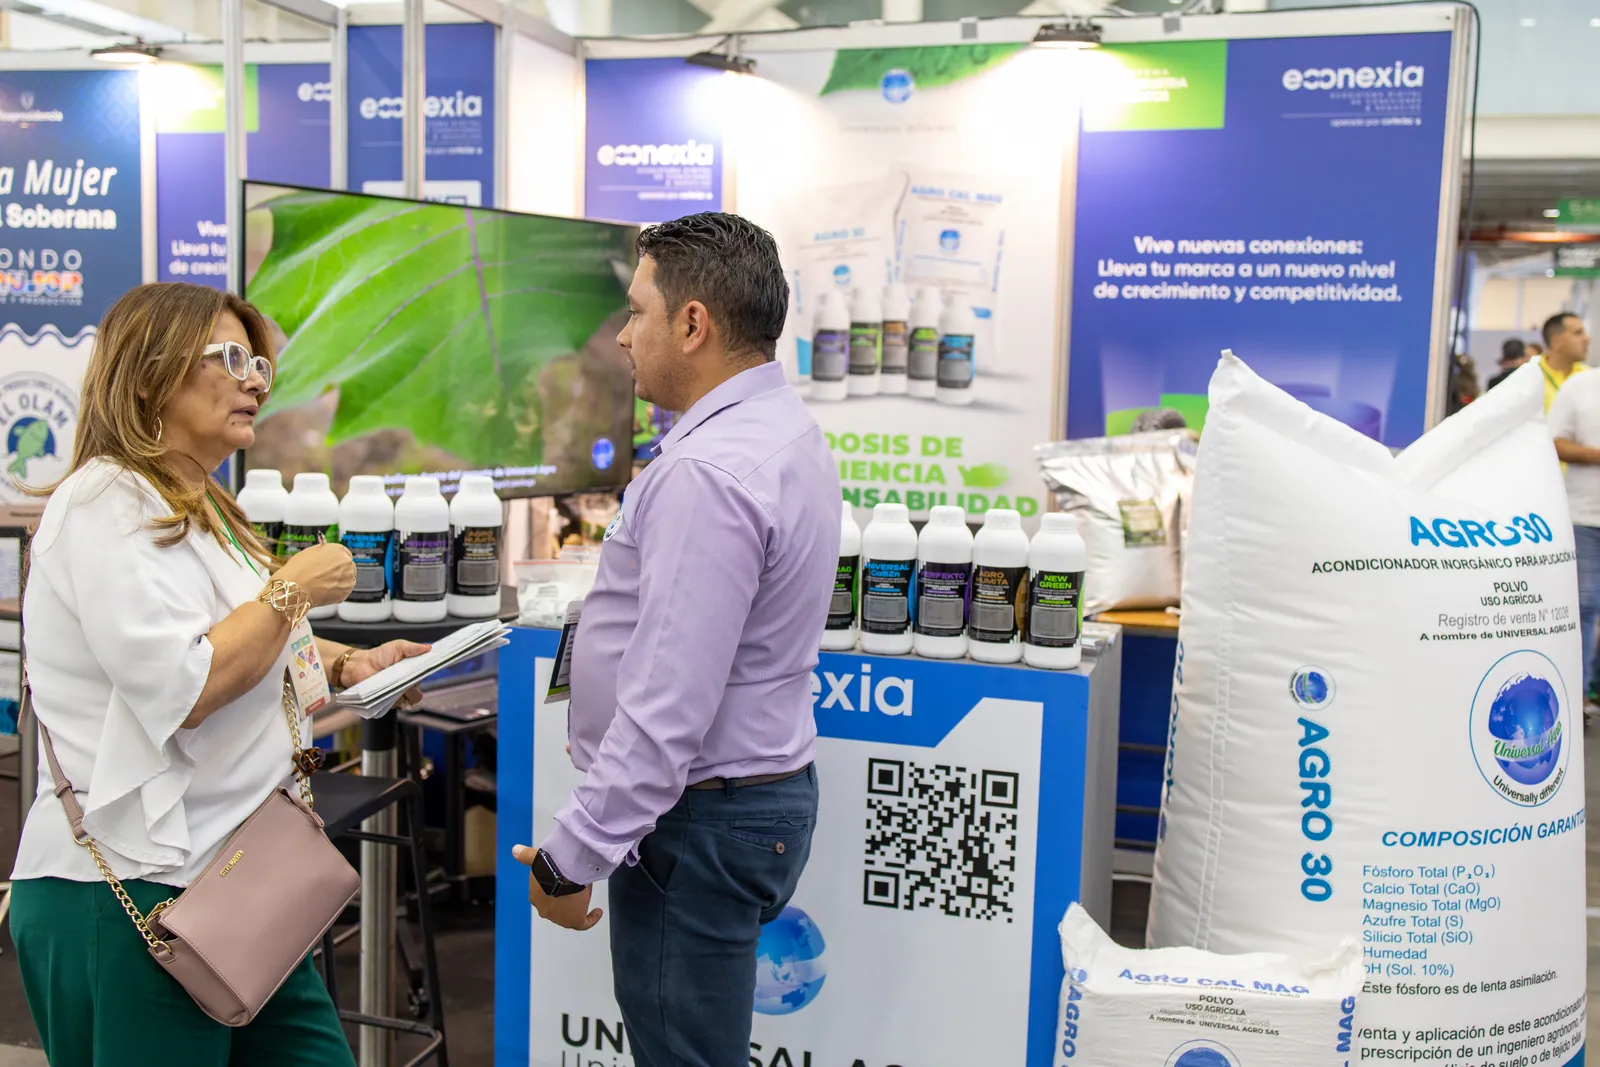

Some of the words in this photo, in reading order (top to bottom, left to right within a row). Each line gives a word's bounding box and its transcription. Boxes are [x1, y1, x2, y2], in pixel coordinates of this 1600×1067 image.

[1282, 61, 1424, 91] econexia
[23, 159, 117, 205] Mujer
[6, 203, 117, 229] Soberana
[1134, 236, 1174, 254] Vive
[1178, 238, 1245, 255] nuevas
[1249, 236, 1363, 255] conexiones:
[1098, 259, 1147, 276] Lleva
[1152, 261, 1170, 277] tu
[1174, 262, 1235, 278] marca
[1239, 263, 1252, 277] a
[1257, 263, 1281, 278] un
[1285, 263, 1345, 279] nuevo
[1349, 261, 1396, 279] nivel
[1094, 283, 1119, 299] de
[1121, 281, 1231, 300] crecimiento
[1234, 286, 1246, 303] y
[1249, 283, 1402, 304] competitividad.
[921, 436, 963, 457] DE
[1311, 558, 1439, 574] ACONDICIONADOR
[1441, 556, 1513, 571] INORGÁNICO
[1515, 555, 1538, 568] PARA
[1039, 581, 1072, 590] GREEN
[1044, 574, 1068, 582] NEW
[1493, 580, 1529, 593] POLVO
[1480, 596, 1500, 606] USO
[1502, 593, 1543, 606] AGRÍCOLA
[1438, 612, 1490, 630] Registro
[1493, 613, 1507, 625] de
[1510, 610, 1537, 624] venta
[1420, 631, 1430, 641] A
[1432, 631, 1478, 641] nombre
[1480, 631, 1493, 640] de
[1496, 628, 1548, 639] UNIVERSAL
[1550, 624, 1567, 635] AGRO
[1494, 738, 1544, 760] Universal
[1297, 717, 1333, 842] AGRO
[1493, 774, 1539, 805] Universally
[1539, 766, 1564, 801] different
[1381, 822, 1532, 847] COMPOSICIÓN
[1300, 852, 1333, 902] 30
[1362, 864, 1414, 879] Fósforo
[1418, 866, 1448, 878] Total
[1362, 882, 1405, 895] Calcio
[1409, 883, 1439, 895] Total
[1443, 882, 1481, 897] (CaO)
[1362, 898, 1428, 913] Magnesio
[1432, 899, 1461, 911] Total
[1465, 897, 1501, 913] (MgO)
[1362, 914, 1406, 927] Azufre
[1411, 916, 1441, 927] Total
[1445, 915, 1464, 930] (S)
[1363, 930, 1402, 943] Silicio
[1406, 932, 1437, 944] Total
[1441, 930, 1473, 946] (SiO)
[1363, 946, 1427, 960] Humedad
[1386, 963, 1416, 977] (Sol.
[1422, 963, 1455, 978] 10%)
[1253, 980, 1310, 994] MAG
[1362, 981, 1392, 995] Este
[1396, 982, 1441, 995] fósforo
[1445, 984, 1459, 995] es
[1462, 982, 1477, 994] de
[1481, 980, 1507, 993] lenta
[1509, 969, 1558, 989] asimilación.
[1185, 1003, 1203, 1012] USO
[1198, 994, 1234, 1006] POLVO
[1062, 985, 1082, 1058] AGRO
[1156, 1015, 1185, 1025] nombre
[1186, 1018, 1196, 1026] de
[1199, 1020, 1240, 1032] UNIVERSAL
[1241, 1025, 1264, 1034] AGRO
[1265, 1028, 1280, 1036] SAS
[1336, 996, 1356, 1053] MAG
[1402, 1030, 1411, 1044] y
[1415, 1025, 1486, 1044] aplicación
[1489, 1023, 1504, 1036] de
[1508, 1019, 1531, 1034] este
[1361, 1045, 1452, 1063] prescripción
[1456, 1045, 1473, 1058] de
[1477, 1044, 1493, 1056] un
[1496, 1035, 1546, 1056] ingeniero
[1530, 1054, 1538, 1065] o
[1539, 1048, 1551, 1062] de
